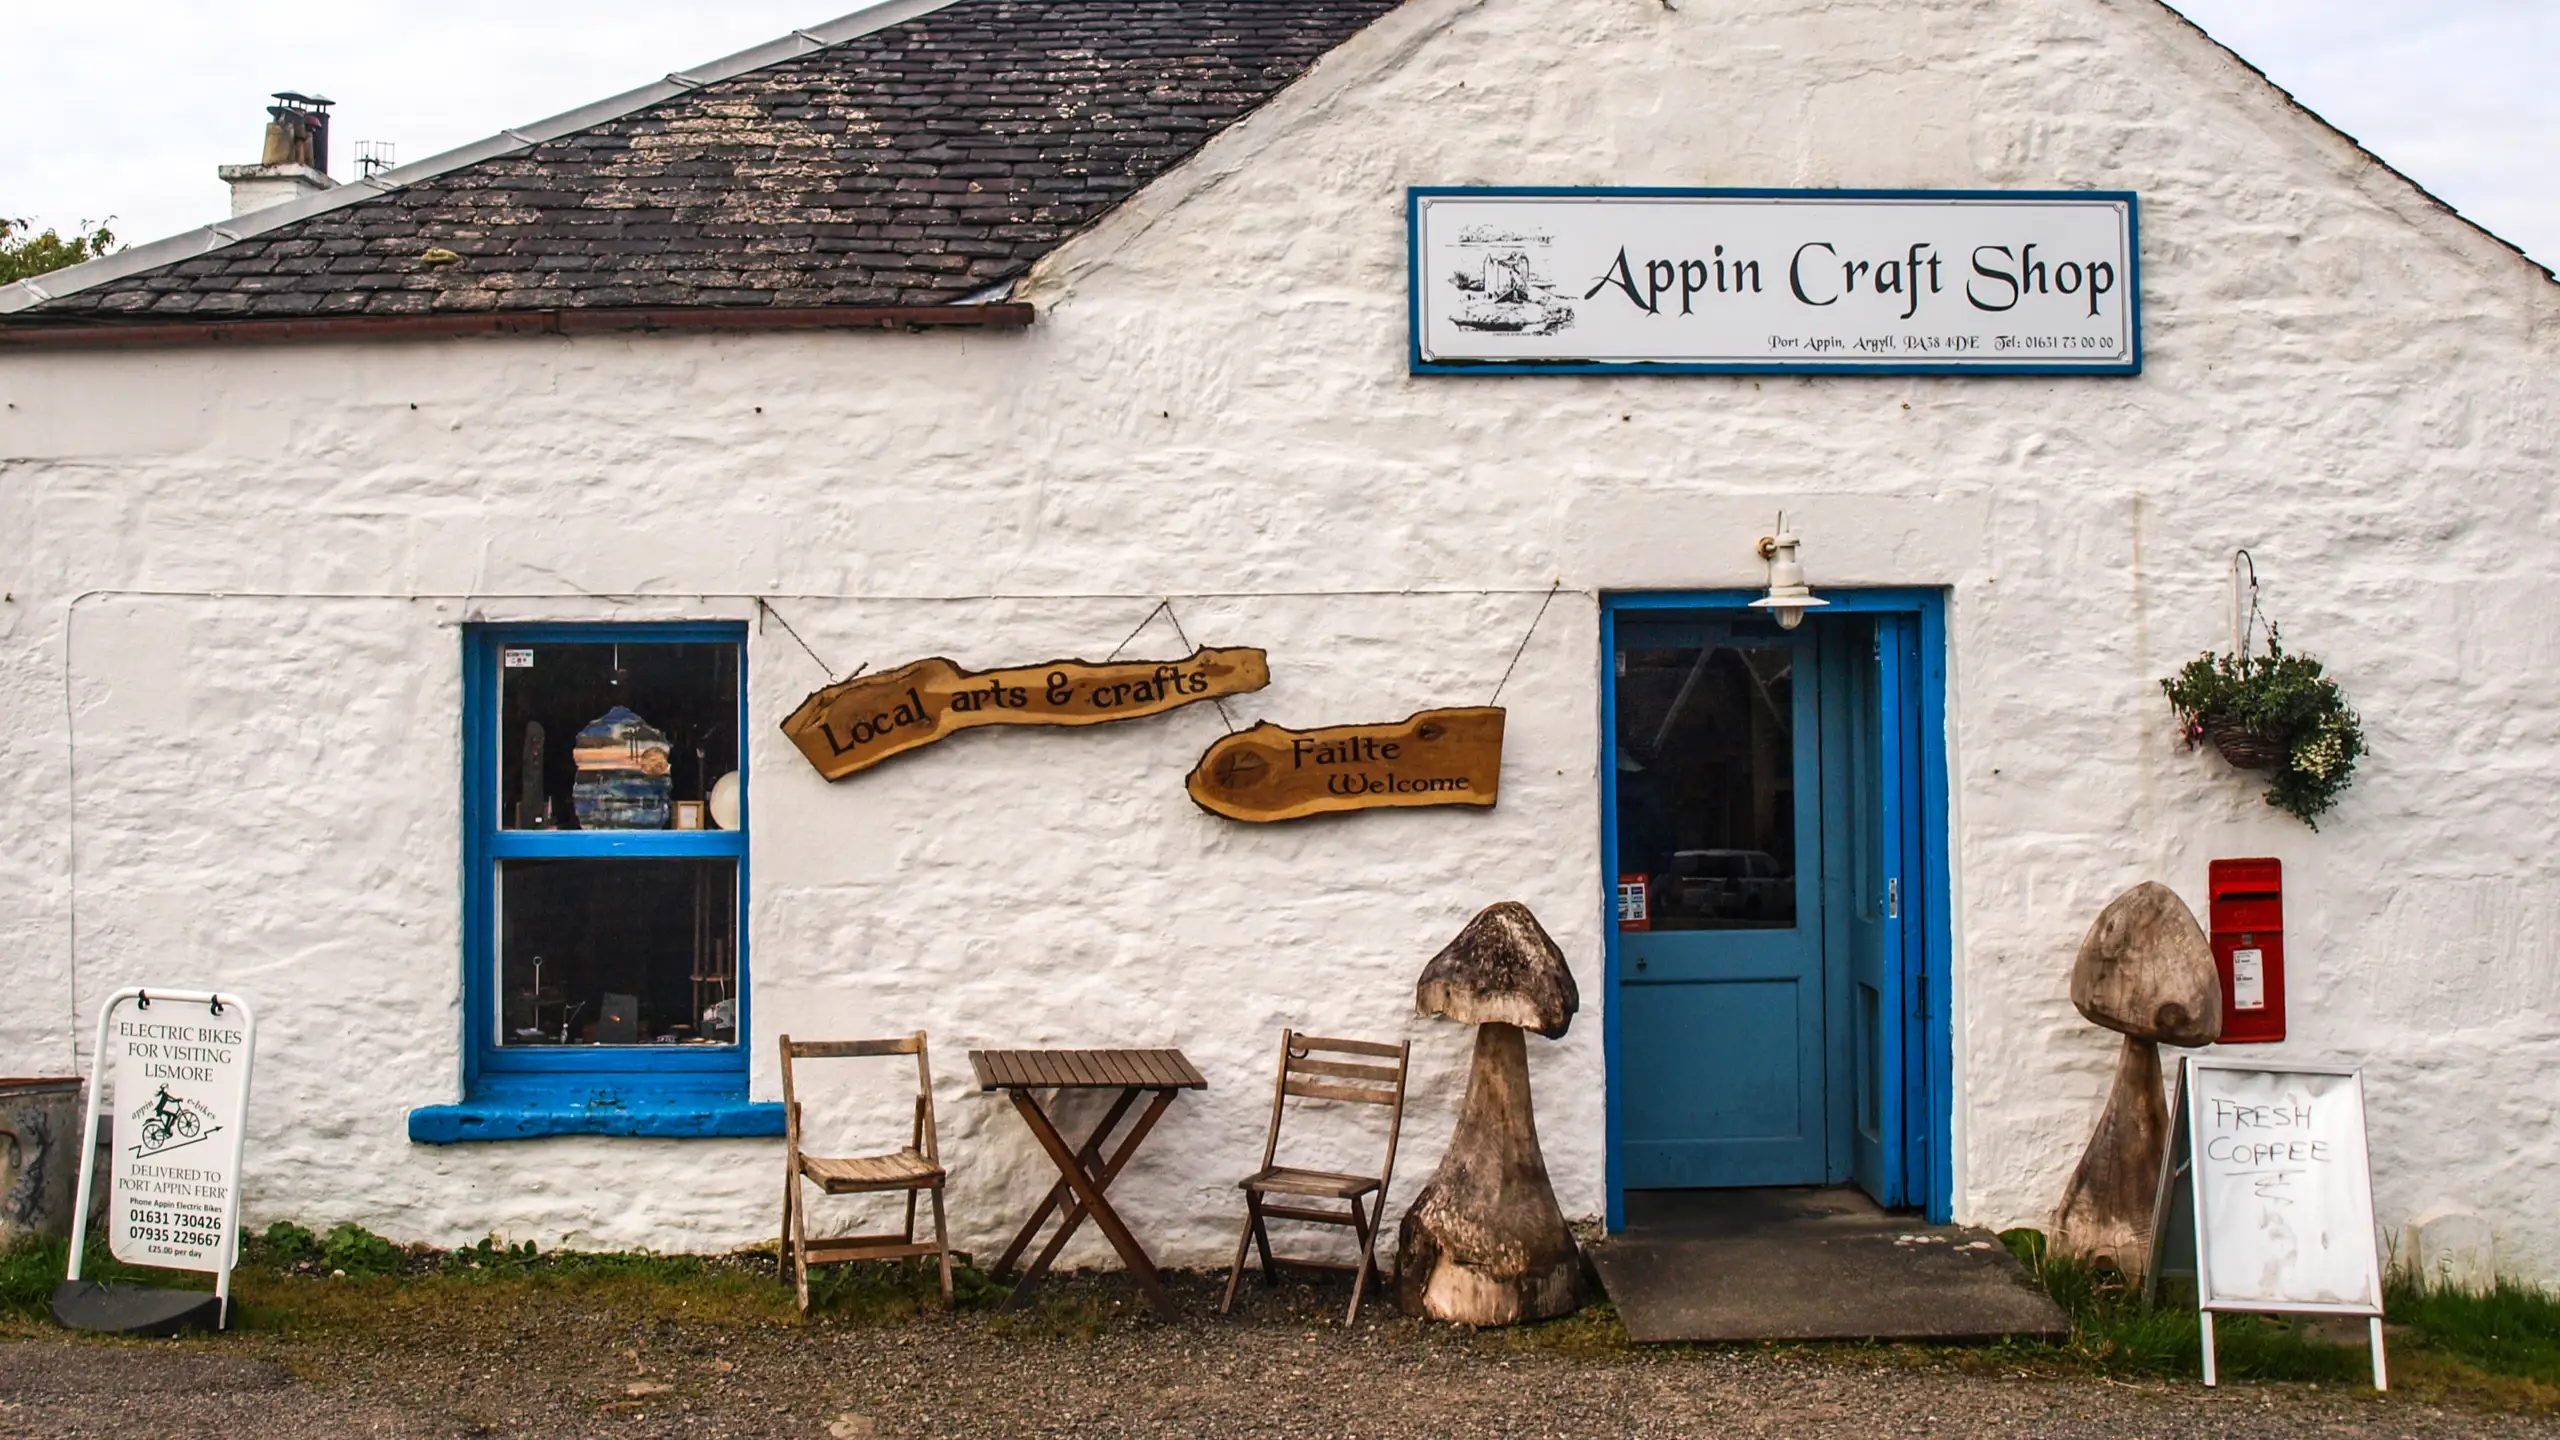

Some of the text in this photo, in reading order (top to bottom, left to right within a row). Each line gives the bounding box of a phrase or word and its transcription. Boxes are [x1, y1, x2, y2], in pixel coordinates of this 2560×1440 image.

[1584, 242, 2114, 320] Appin Craft Shop
[1767, 335, 2114, 353] Port Appin, Argyll, PA38 4DE Tel: 01631 73 00 00
[820, 665, 1209, 757] Local arts & crafts
[1327, 773, 1470, 795] Welcome
[120, 1022, 242, 1045] ELECTRIC BIKES
[128, 1042, 232, 1064] FOR VISITING
[145, 1063, 214, 1082] LISMORE
[131, 1099, 154, 1120] appin
[186, 1098, 216, 1120] e-bikes
[2211, 1098, 2312, 1131] FRESH
[2208, 1136, 2332, 1166] COFFEE
[131, 1164, 222, 1183] DELIVERED TO
[119, 1178, 151, 1192] PORT
[153, 1182, 192, 1196] APPIN
[130, 1197, 222, 1213] Phone Appin Electric Bikes
[130, 1209, 221, 1230] 01631 730426
[130, 1226, 221, 1247] 07935 229667
[148, 1244, 203, 1258] £25.00 per day
